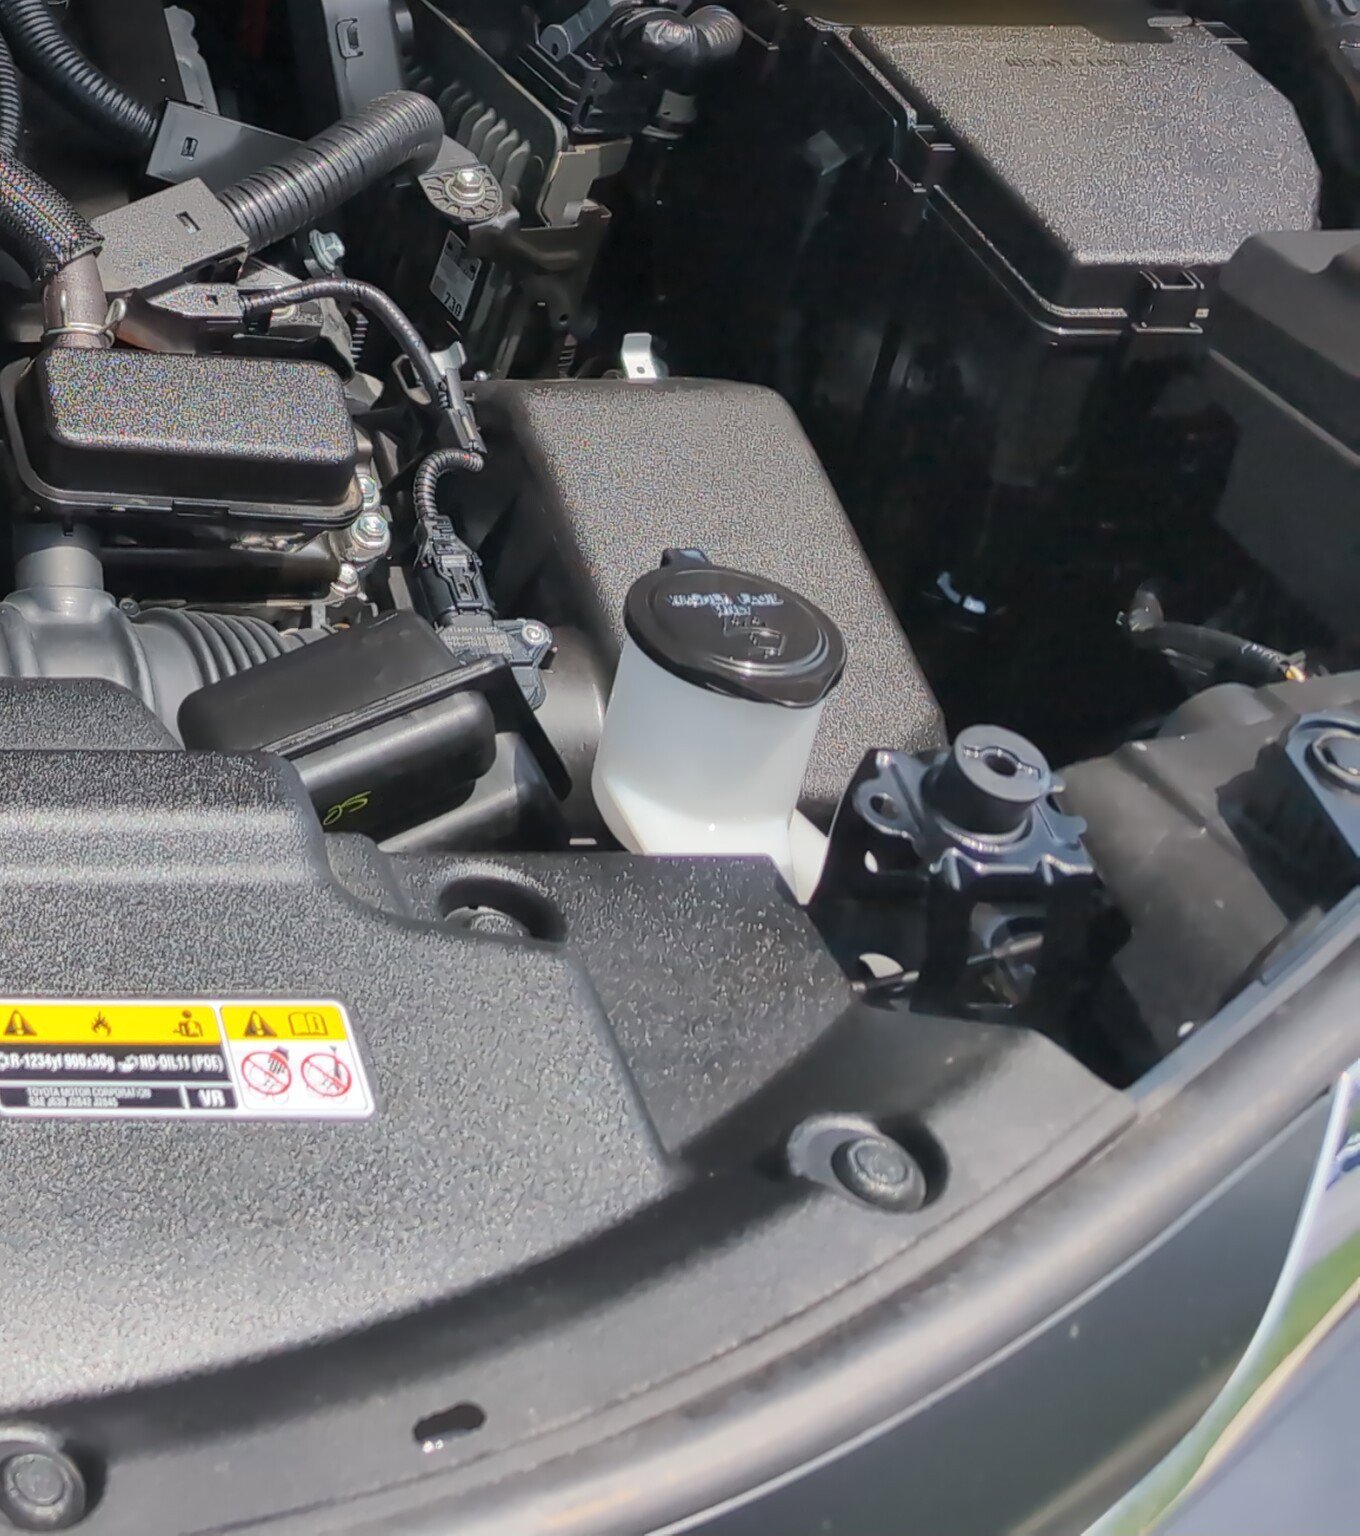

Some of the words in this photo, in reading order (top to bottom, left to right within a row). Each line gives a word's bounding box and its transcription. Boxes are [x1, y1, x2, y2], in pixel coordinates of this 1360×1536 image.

[139, 1053, 191, 1071] ND-OIL11
[192, 1054, 224, 1073] (POE)
[26, 1086, 60, 1098] TOYOTA
[198, 1088, 226, 1107] VR
